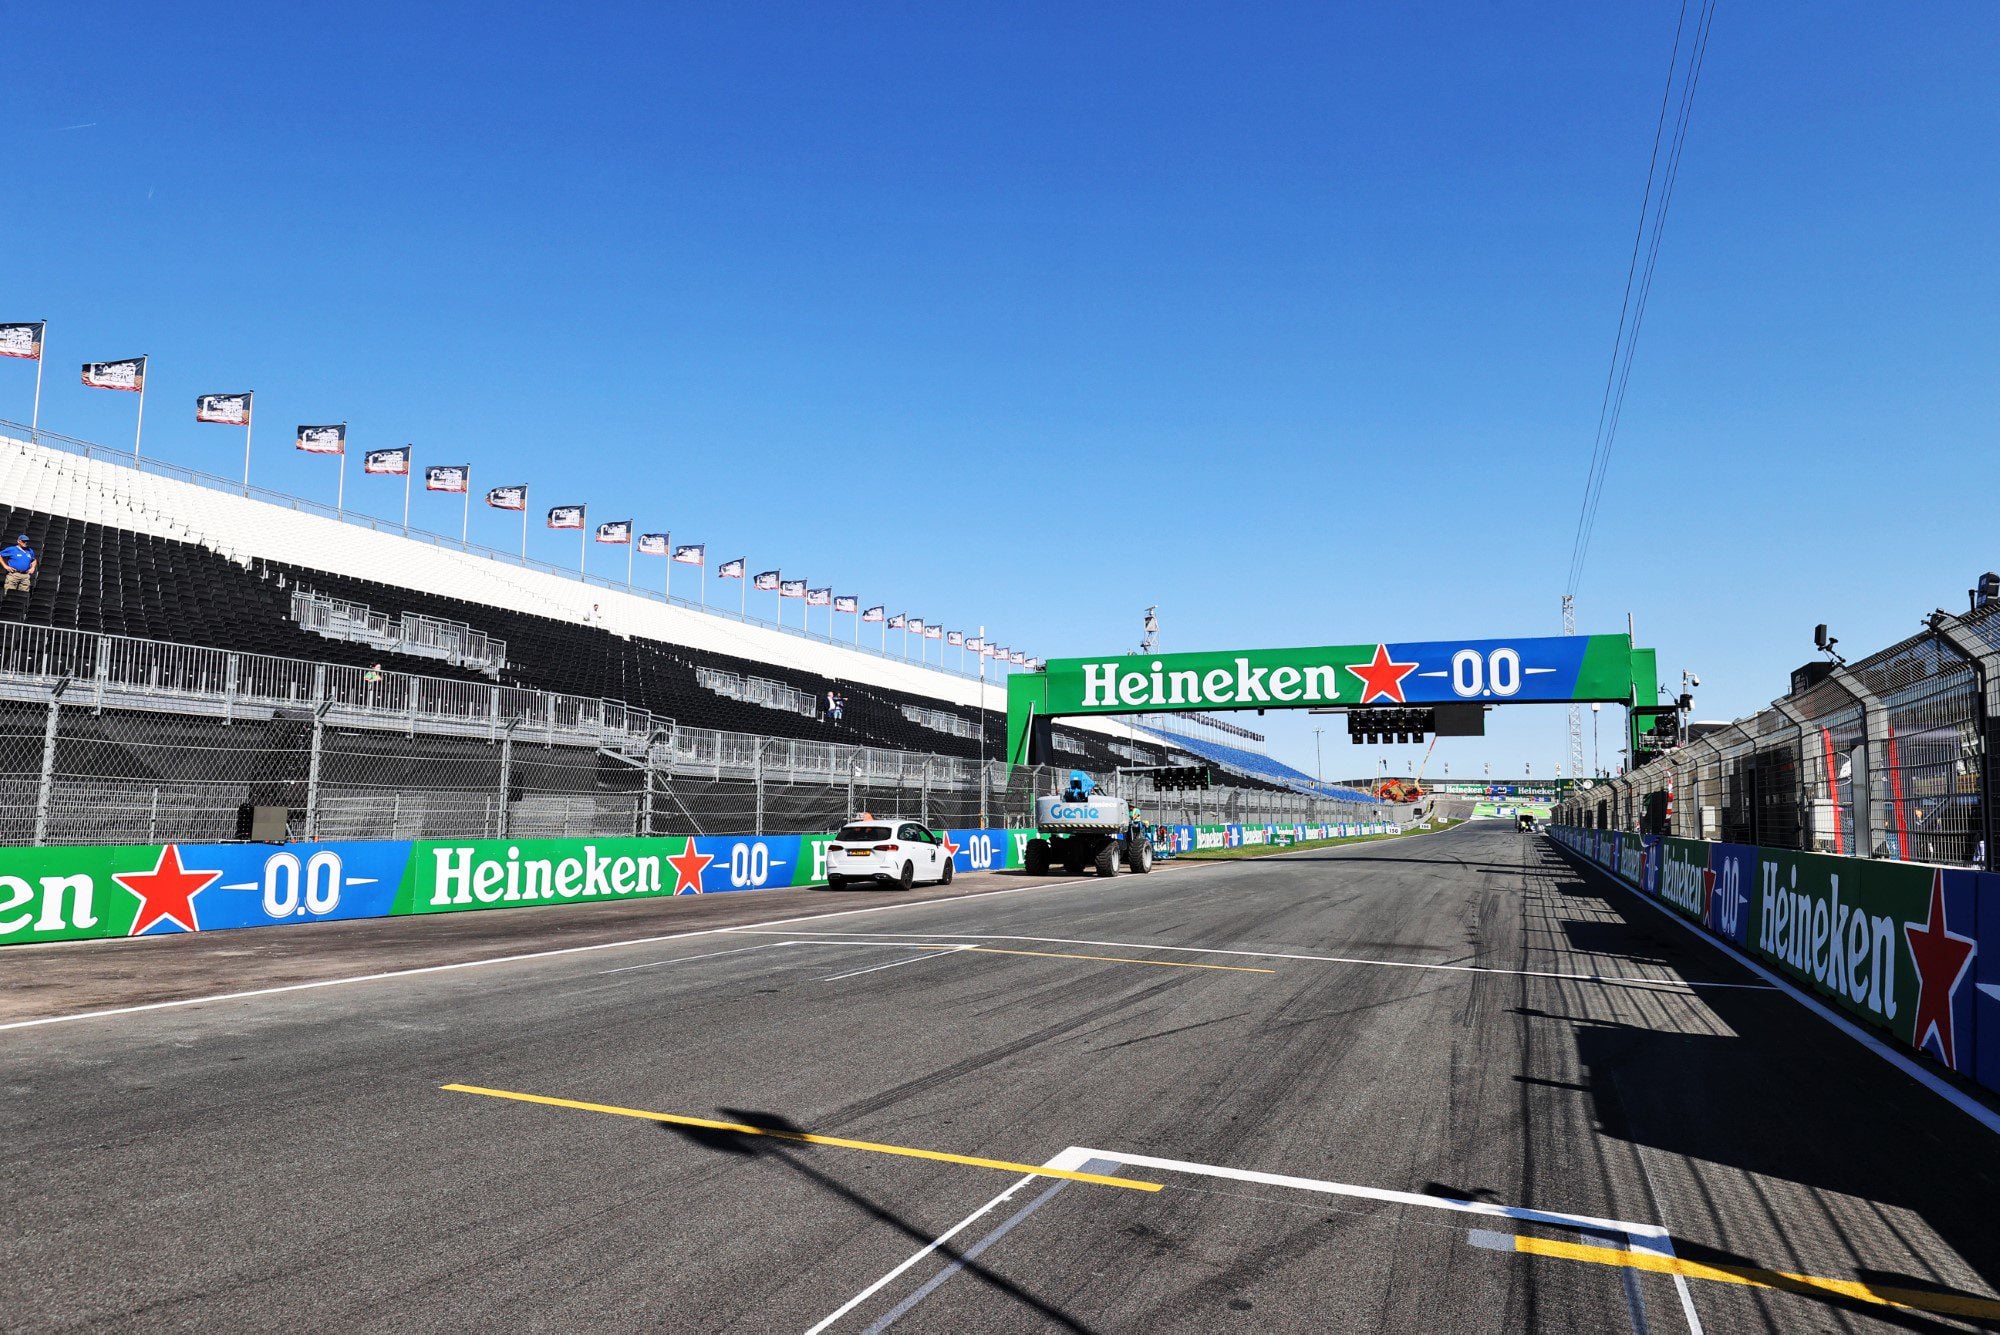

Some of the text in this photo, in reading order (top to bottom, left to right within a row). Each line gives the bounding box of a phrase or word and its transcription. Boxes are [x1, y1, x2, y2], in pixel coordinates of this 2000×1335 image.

[1081, 648, 1522, 707] Heineken 0.0
[1050, 803, 1099, 819] Genie
[262, 850, 343, 919] 0.0
[429, 845, 662, 905] Heineken
[730, 842, 769, 888] 0.0
[1661, 844, 1702, 916] Heineken
[1759, 860, 1898, 1021] Heineken
